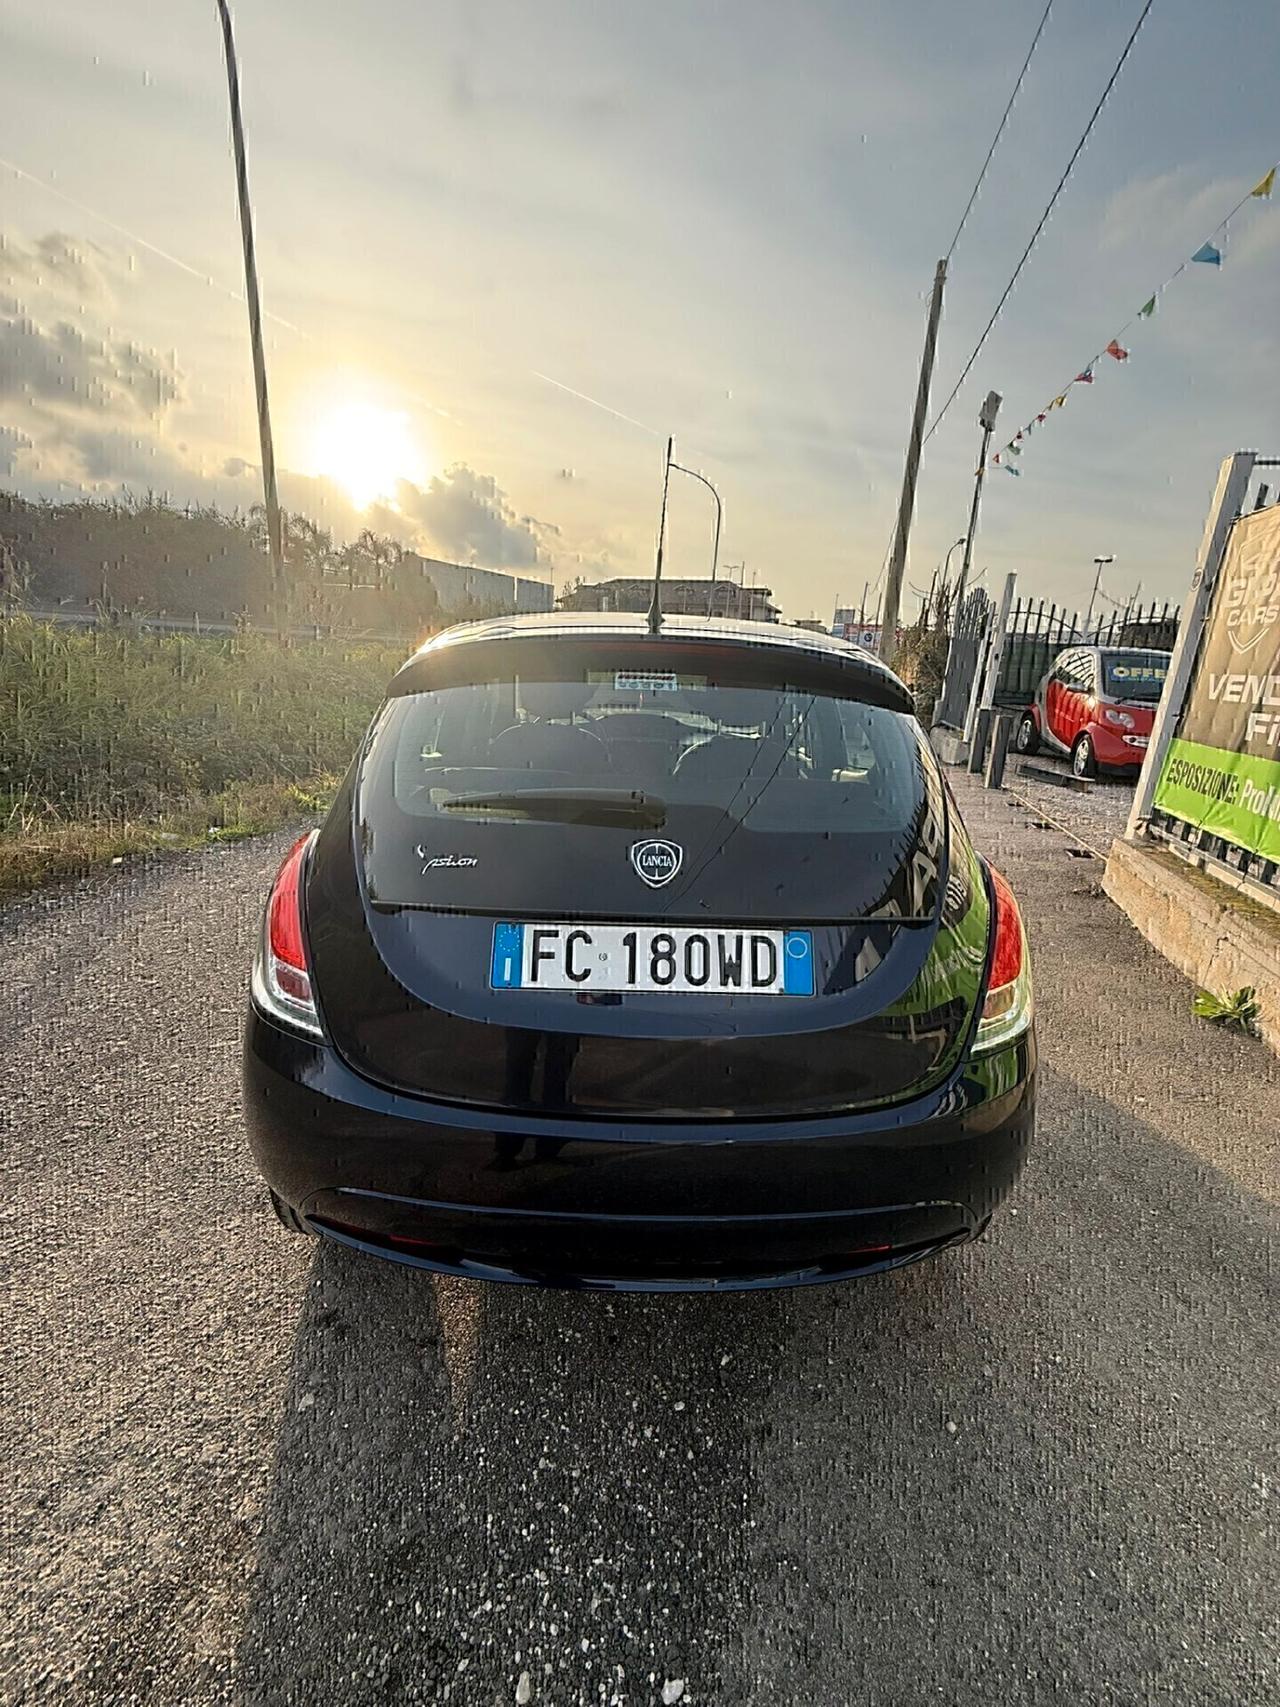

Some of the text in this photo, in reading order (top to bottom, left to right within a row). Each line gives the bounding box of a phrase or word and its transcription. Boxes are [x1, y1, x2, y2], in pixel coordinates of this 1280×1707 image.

[1226, 604, 1279, 627] CARS
[1166, 758, 1240, 805] ESPOSIZIONE:
[642, 855, 673, 867] LANCIA
[530, 929, 593, 983] FC
[622, 931, 777, 988] 180WD
